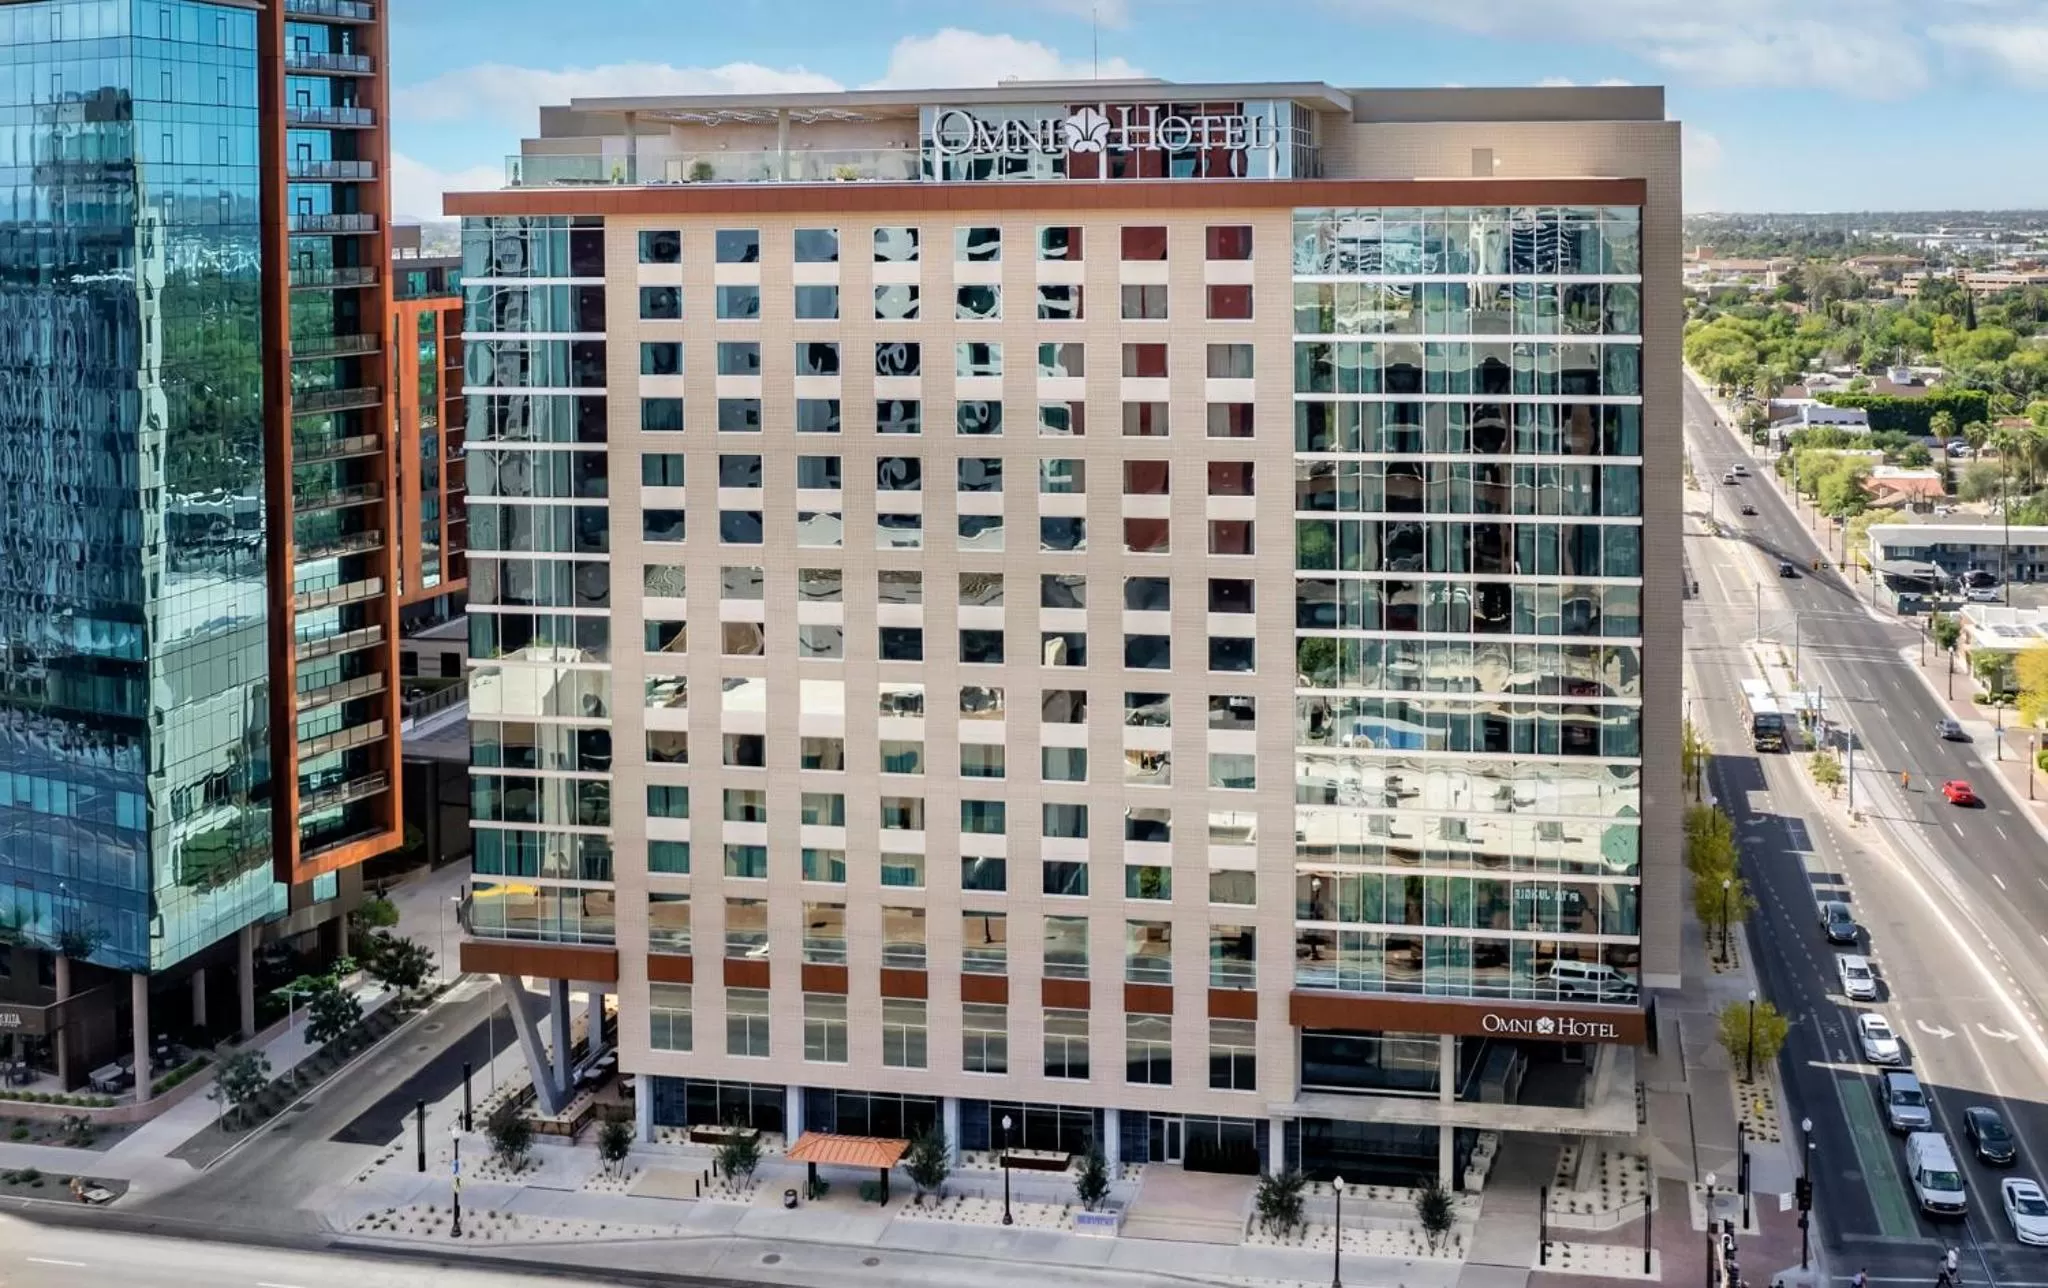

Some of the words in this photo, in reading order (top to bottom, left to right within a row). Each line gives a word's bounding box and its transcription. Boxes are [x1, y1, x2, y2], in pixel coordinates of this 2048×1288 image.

[932, 109, 1059, 155] OMNI
[1116, 106, 1275, 152] HOTEL
[1482, 1014, 1533, 1033] OMNI
[1558, 1017, 1619, 1037] HOTEL
